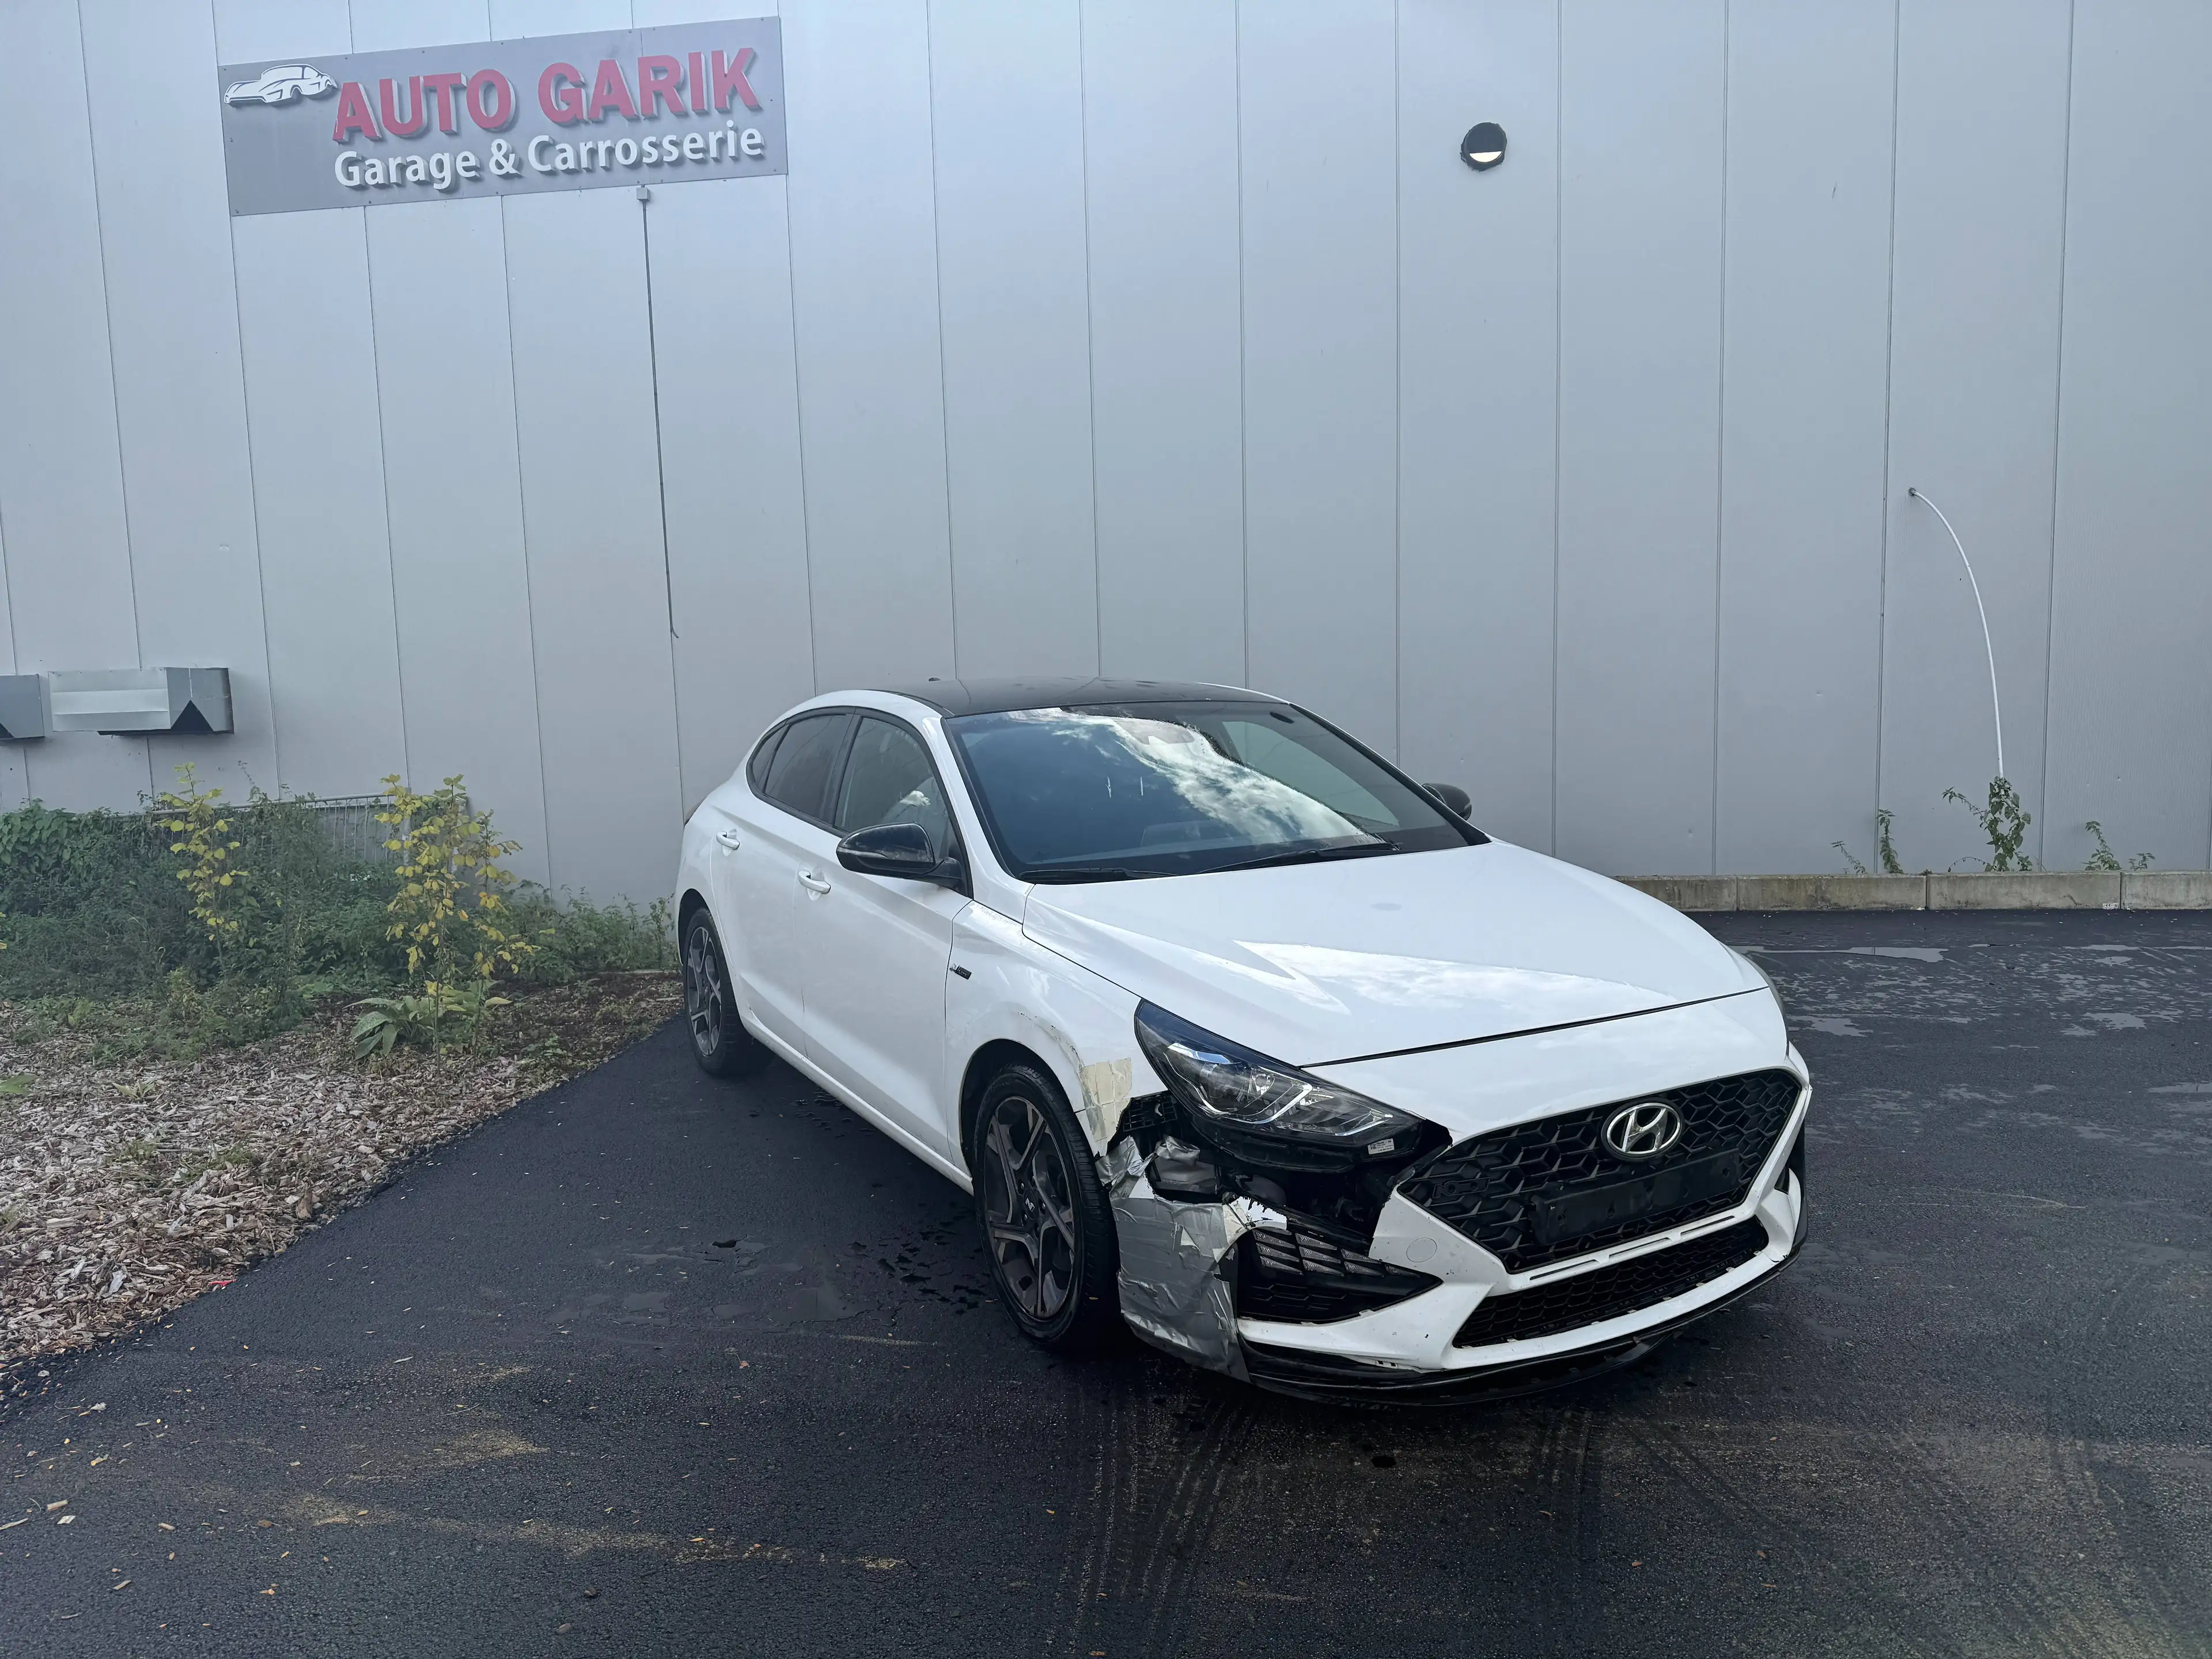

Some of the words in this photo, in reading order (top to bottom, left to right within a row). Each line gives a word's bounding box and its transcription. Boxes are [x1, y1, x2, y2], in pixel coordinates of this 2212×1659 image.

[332, 69, 516, 142] AUTO
[537, 47, 762, 123] GARIK
[335, 150, 480, 190] Garage
[489, 138, 521, 175] &
[528, 120, 764, 172] Carrosserie
